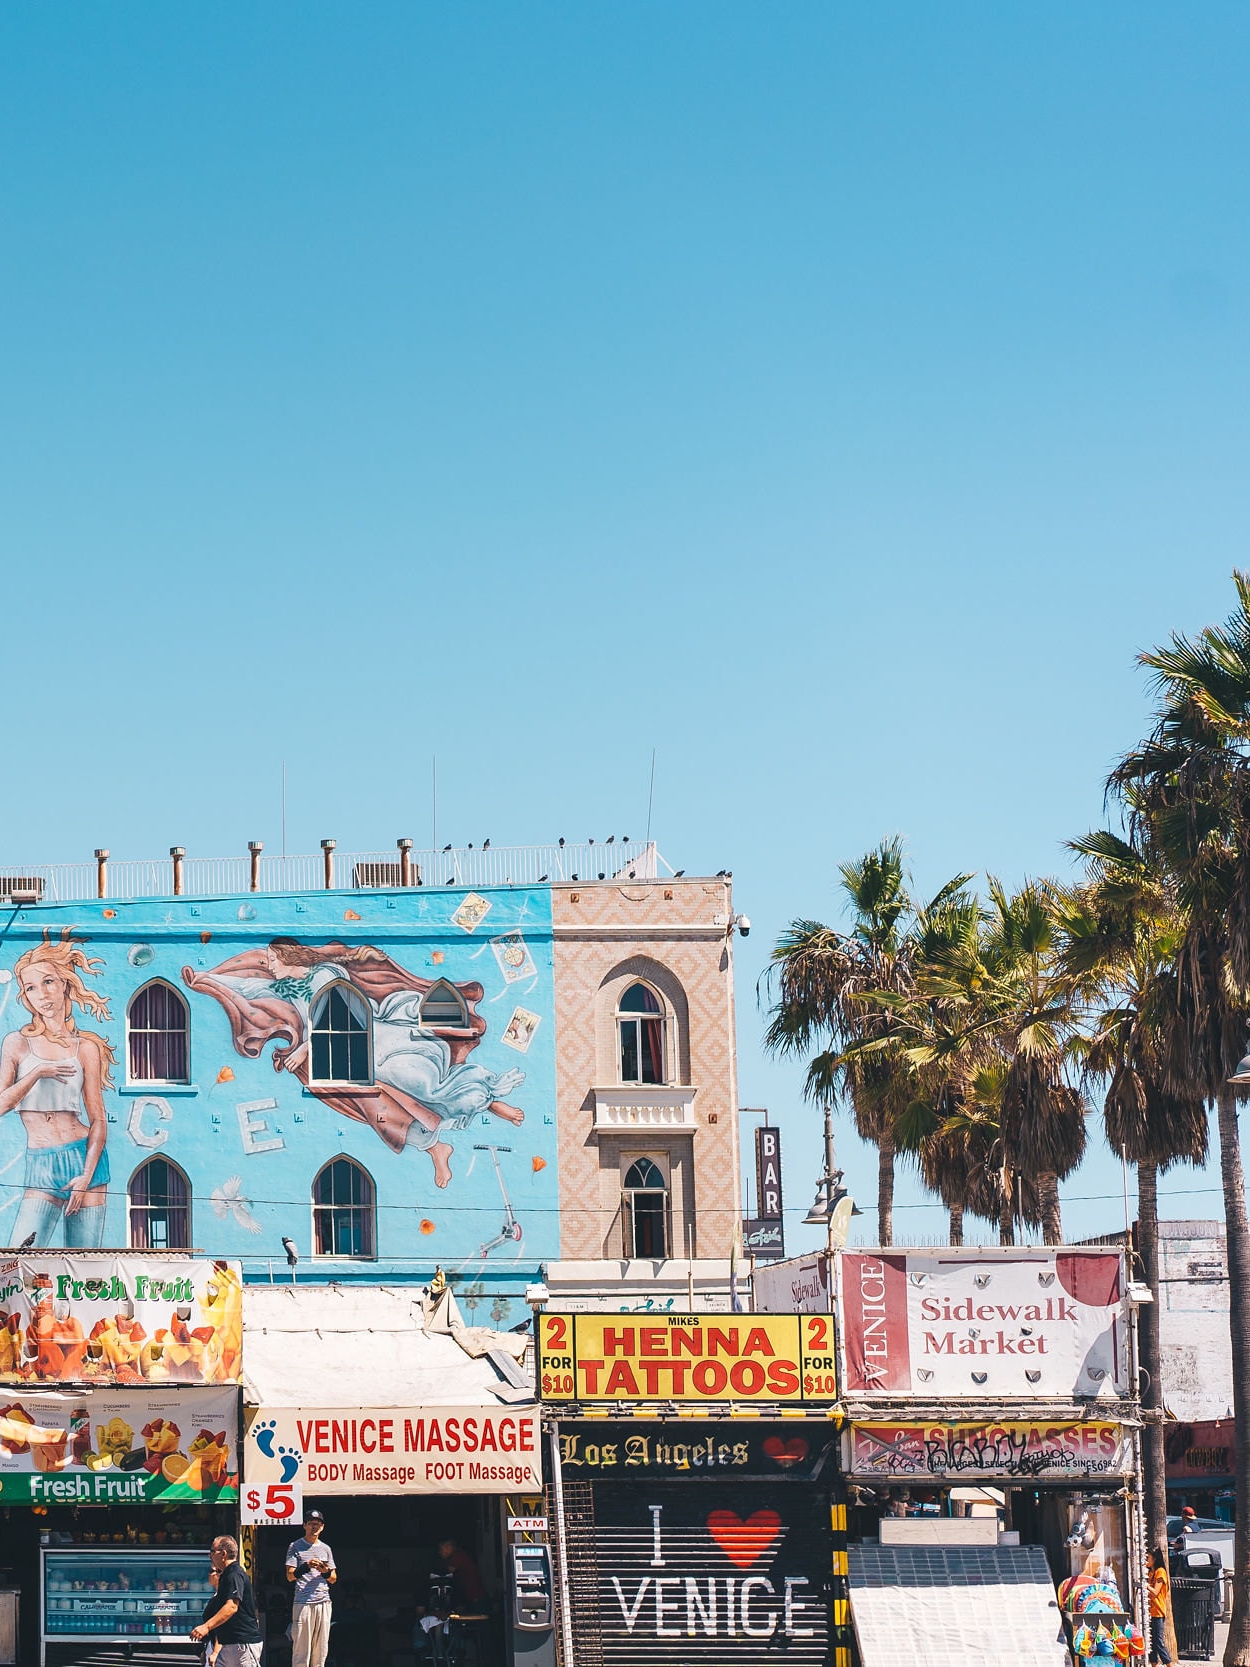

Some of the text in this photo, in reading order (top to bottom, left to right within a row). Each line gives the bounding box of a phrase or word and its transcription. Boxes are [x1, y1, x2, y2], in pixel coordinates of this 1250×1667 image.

[763, 1134, 779, 1214] BAR
[1, 1258, 20, 1273] ZING
[56, 1274, 127, 1301] Fresh
[134, 1276, 194, 1302] Fruit
[668, 1317, 699, 1326] MIKES
[860, 1260, 889, 1382] VENICE
[921, 1297, 1078, 1322] Sidewalk
[546, 1316, 567, 1350] 2
[603, 1327, 776, 1357] HENNA
[807, 1317, 828, 1351] 2
[922, 1331, 1049, 1355] Market
[542, 1356, 572, 1369] FOR
[804, 1357, 833, 1370] FOR
[542, 1373, 574, 1395] $10
[577, 1359, 800, 1396] TATTOOS
[803, 1374, 835, 1396] $10
[296, 1417, 535, 1454] VENICE MASSAGE
[558, 1434, 749, 1470] Los Angeles
[29, 1474, 146, 1497] Fresh Fruit
[307, 1462, 532, 1485] BODY Massage FOOT Massage
[246, 1484, 296, 1519] $5
[513, 1520, 544, 1528] ATM
[649, 1505, 666, 1566] I
[611, 1576, 815, 1636] VENICE
